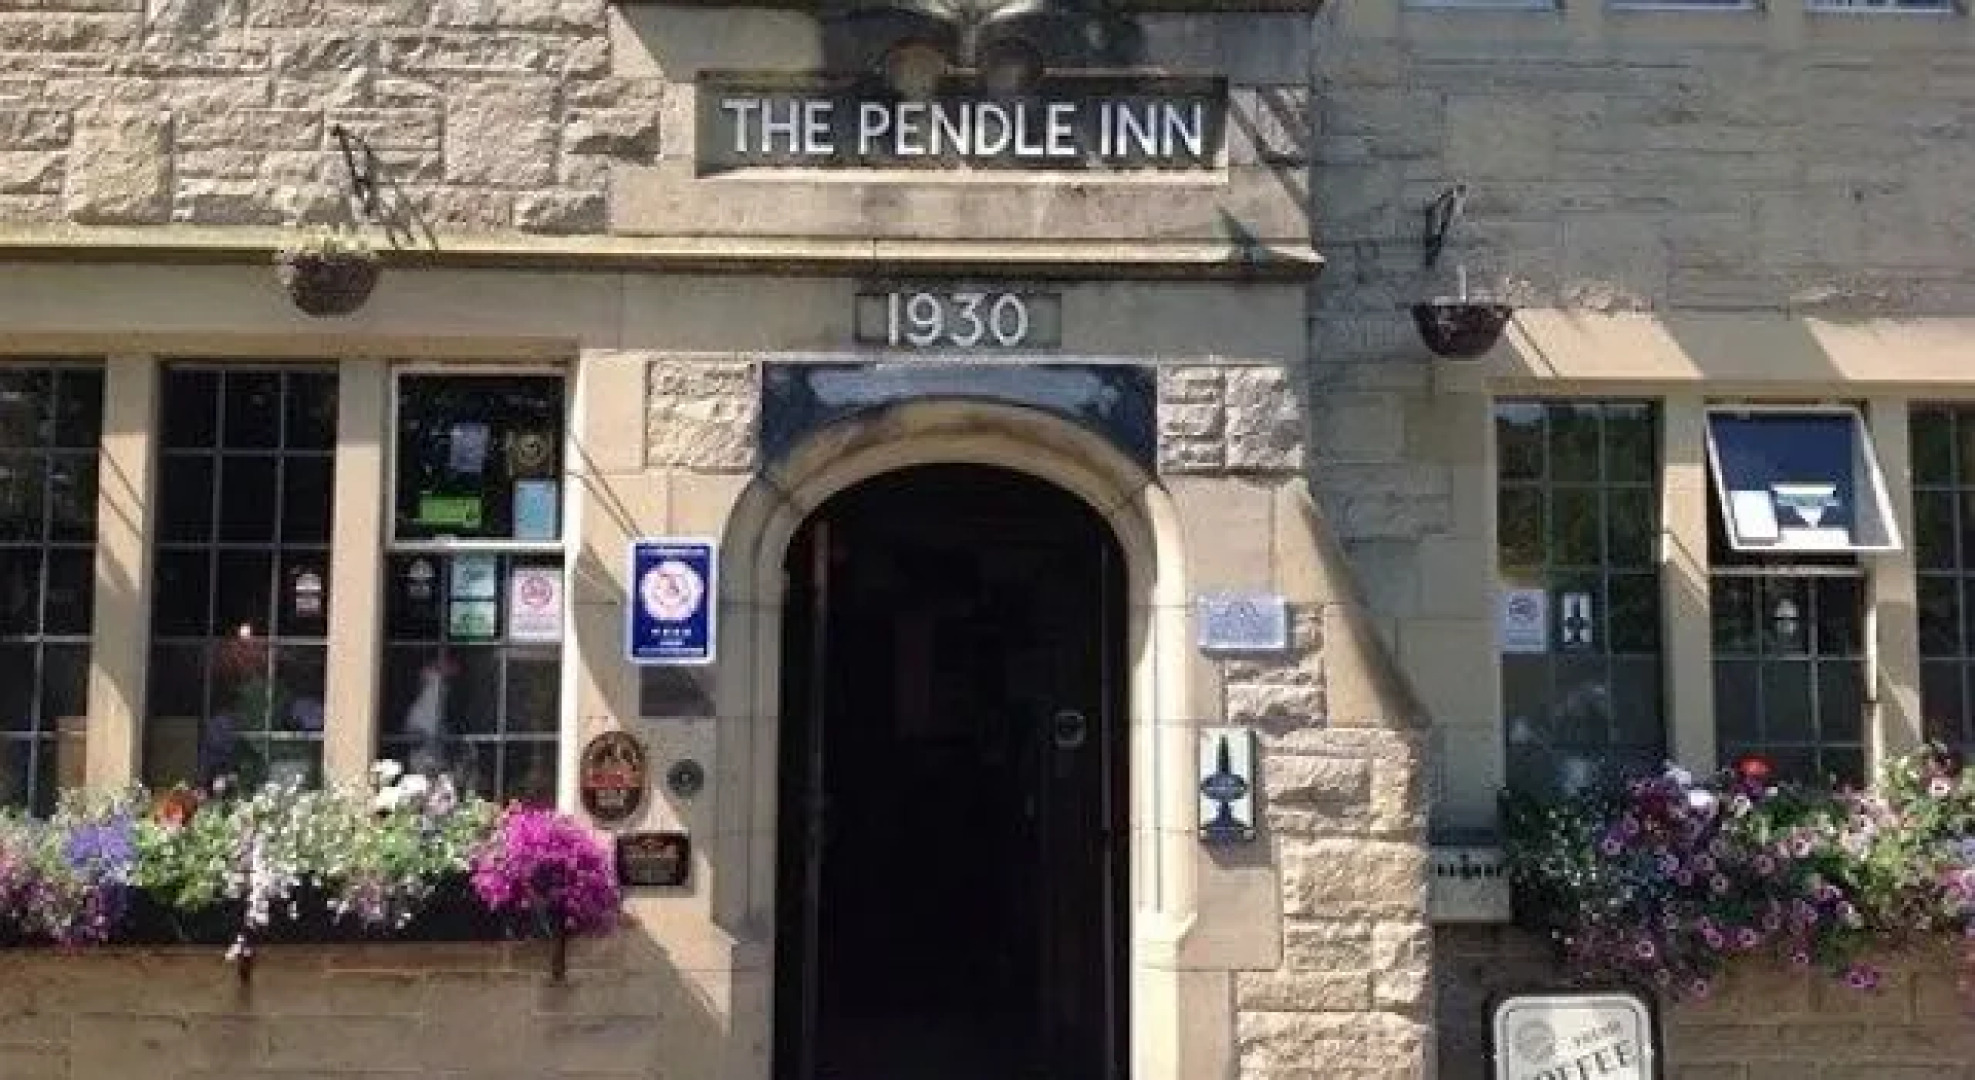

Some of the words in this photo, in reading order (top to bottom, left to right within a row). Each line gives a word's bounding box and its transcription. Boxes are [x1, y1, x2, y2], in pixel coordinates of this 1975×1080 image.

[722, 99, 834, 153] THE
[858, 101, 1077, 157] PENDLE
[1100, 101, 1204, 157] INN
[887, 292, 1029, 347] 1930
[1522, 1039, 1637, 1080] FFEE
